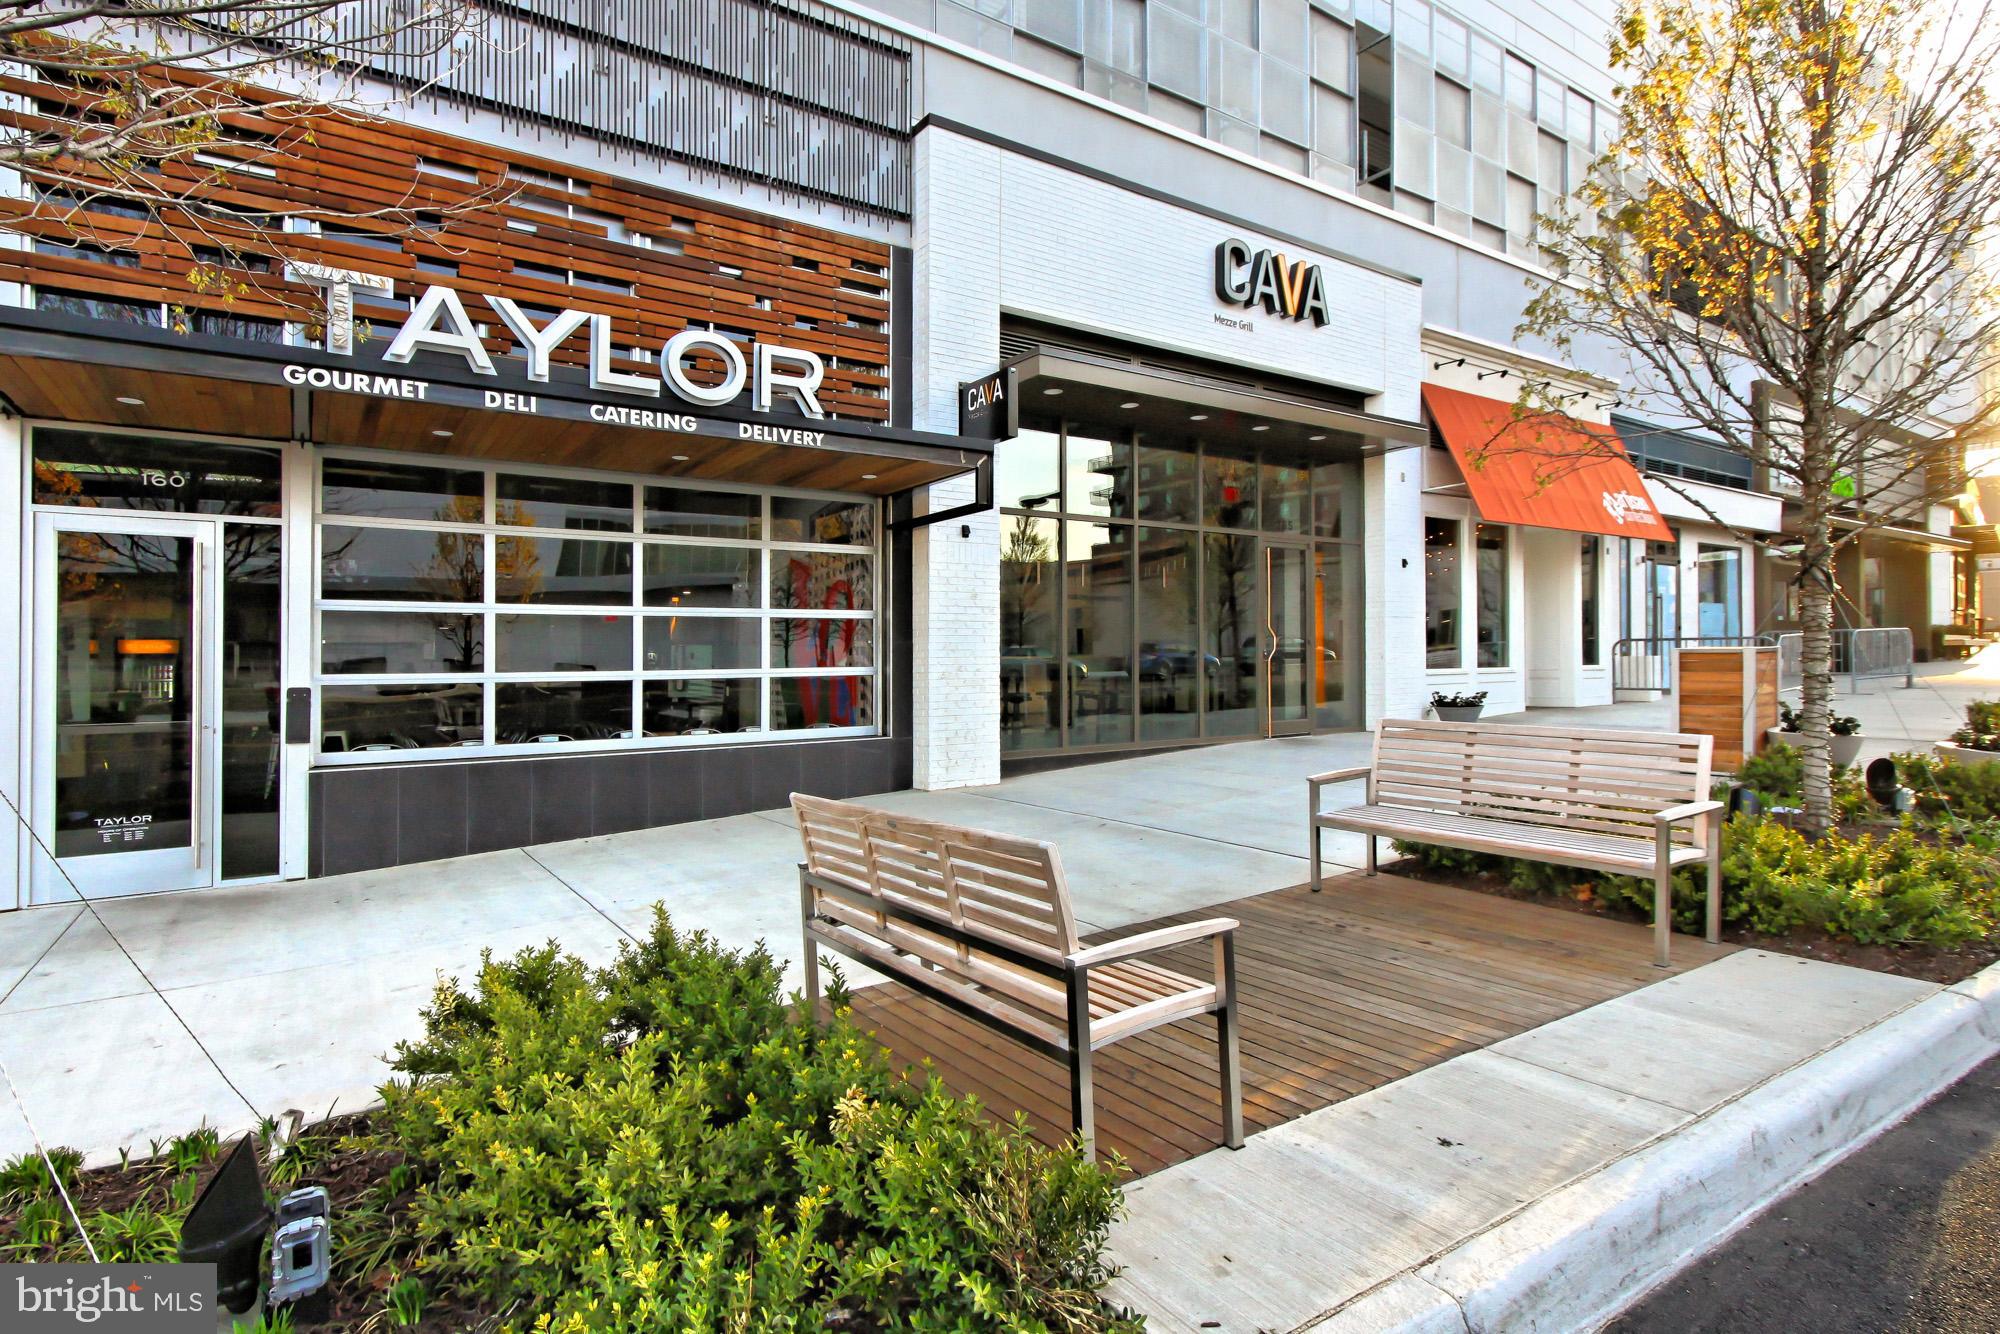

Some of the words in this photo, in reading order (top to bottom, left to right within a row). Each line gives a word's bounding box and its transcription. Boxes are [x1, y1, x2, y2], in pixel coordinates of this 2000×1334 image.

[1215, 238, 1331, 328] CAVA
[284, 260, 826, 420] TAYLOR
[1214, 313, 1238, 328] Mezze
[1239, 319, 1254, 333] Grill
[282, 365, 429, 401] GOURMET
[484, 391, 538, 413] DELI
[589, 404, 698, 433] CATERING
[738, 423, 826, 448] DELIVERY
[967, 377, 1003, 411] CAVA
[141, 472, 185, 487] 160
[94, 815, 152, 826] TAYLOR
